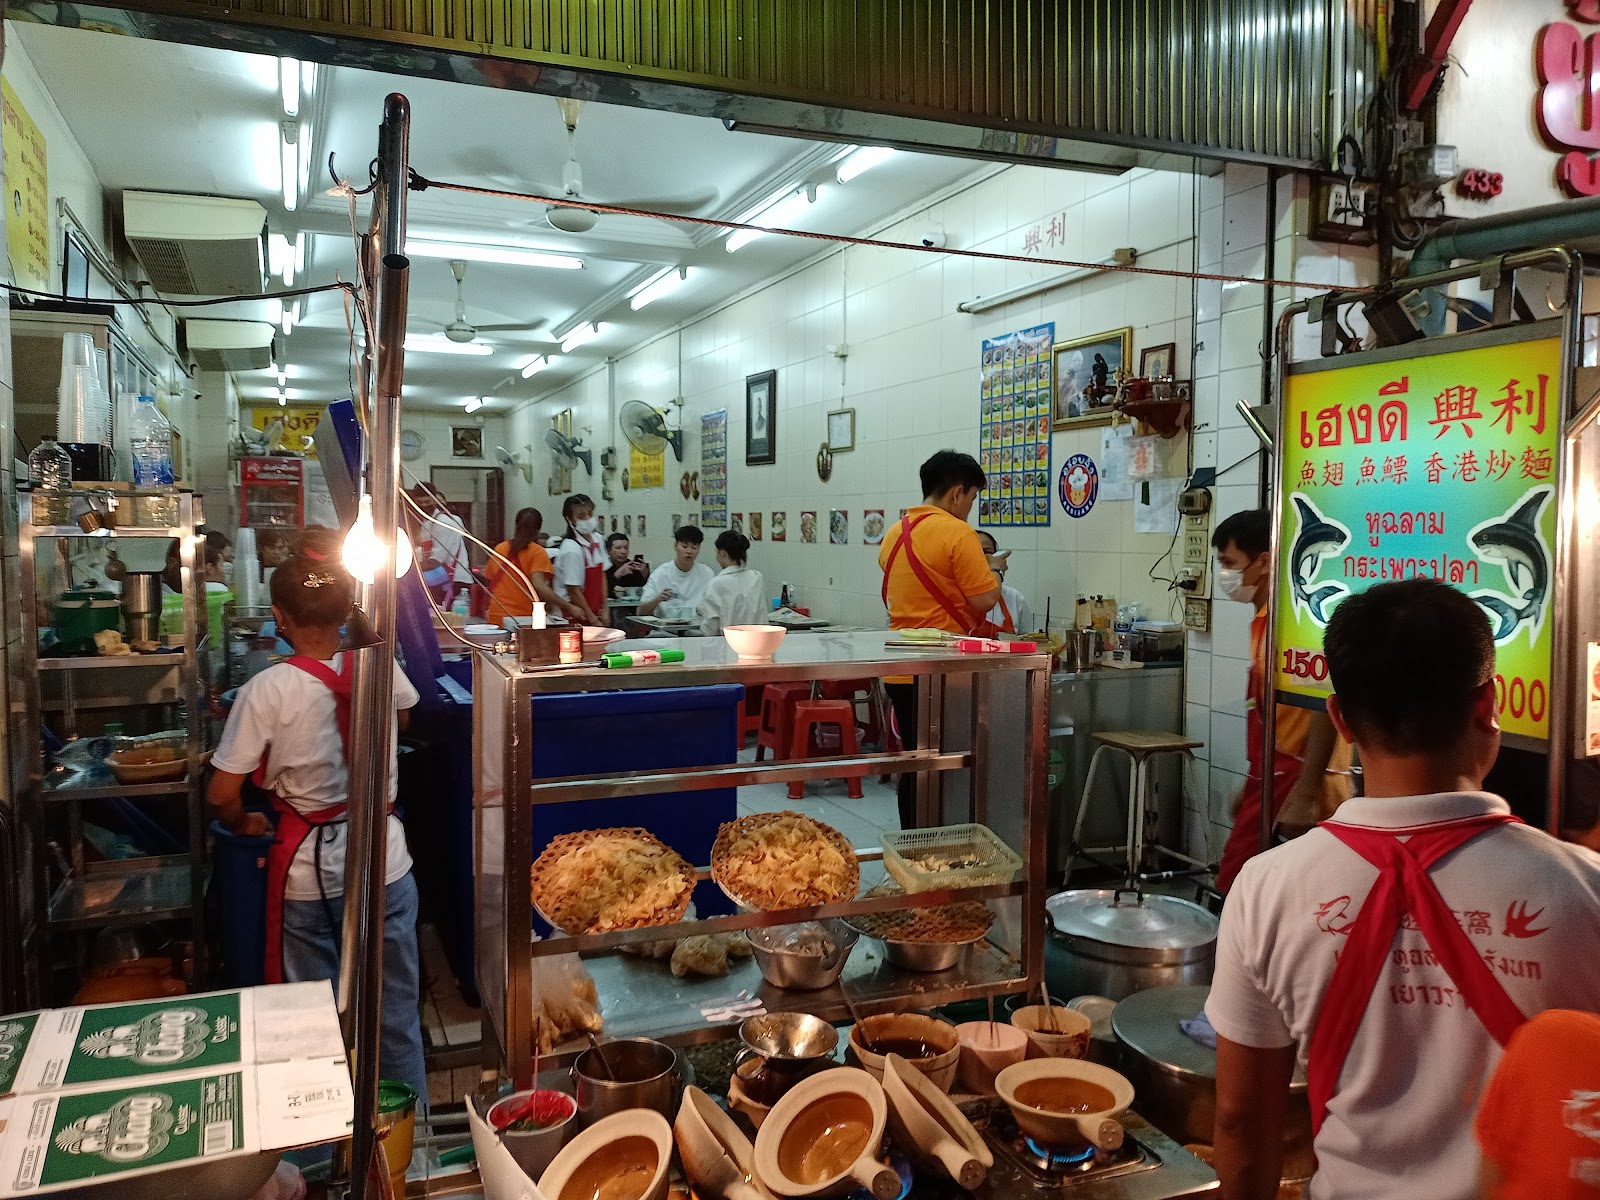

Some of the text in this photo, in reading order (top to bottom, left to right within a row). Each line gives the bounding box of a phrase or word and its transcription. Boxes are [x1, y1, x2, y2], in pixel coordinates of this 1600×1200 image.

[1462, 168, 1503, 196] 433
[1022, 212, 1066, 255] 興利
[1299, 374, 1549, 448] เฮงดี 興利
[1297, 445, 1553, 488] 魚翅 魚鰾 香港炒麵
[1365, 511, 1445, 547] หูฉลาม
[1343, 554, 1479, 584] กระเพาะปลา
[142, 1010, 197, 1062] Chang
[111, 1097, 162, 1157] Chang
